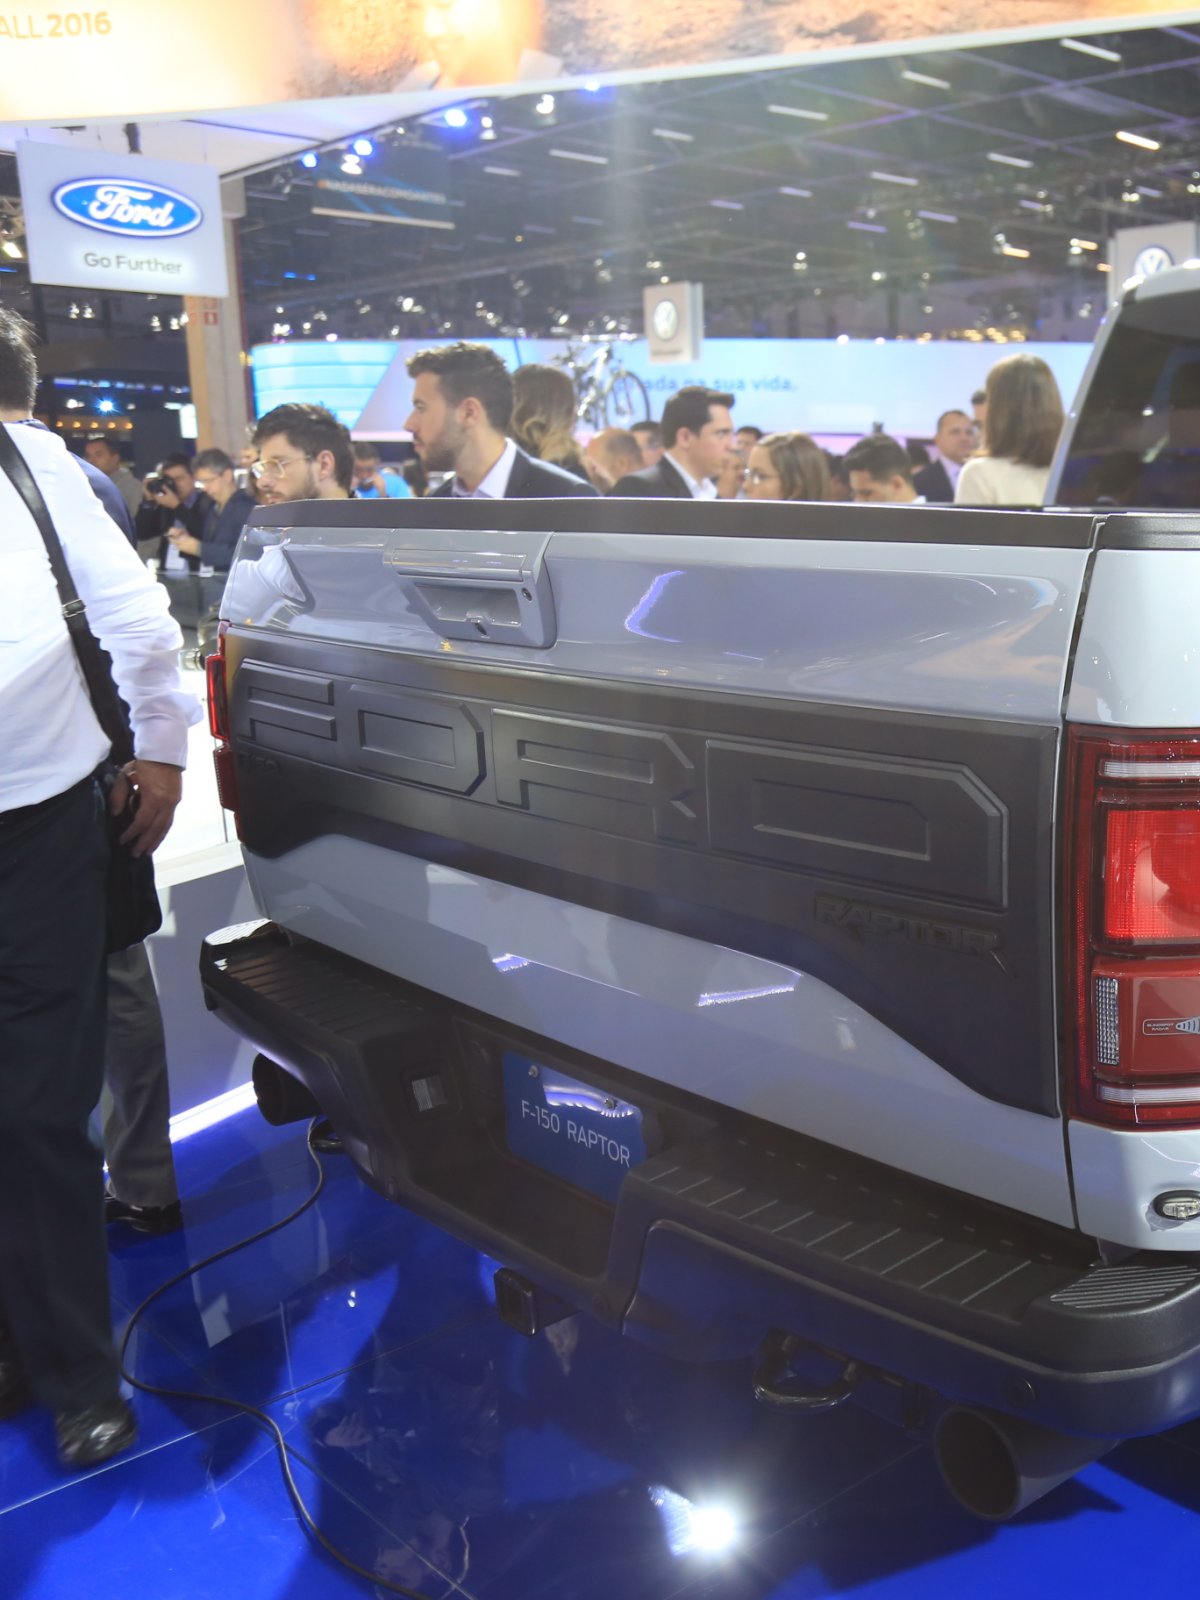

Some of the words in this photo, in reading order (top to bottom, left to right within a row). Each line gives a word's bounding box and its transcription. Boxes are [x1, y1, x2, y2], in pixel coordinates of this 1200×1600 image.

[47, 11, 112, 38] 2016
[88, 184, 174, 228] Ford
[84, 252, 111, 269] Go
[116, 254, 182, 275] Further
[232, 658, 1010, 914] FORD
[813, 892, 1010, 975] RAPTOR
[521, 1099, 560, 1134] F-150
[566, 1119, 630, 1169] RAPTOR
